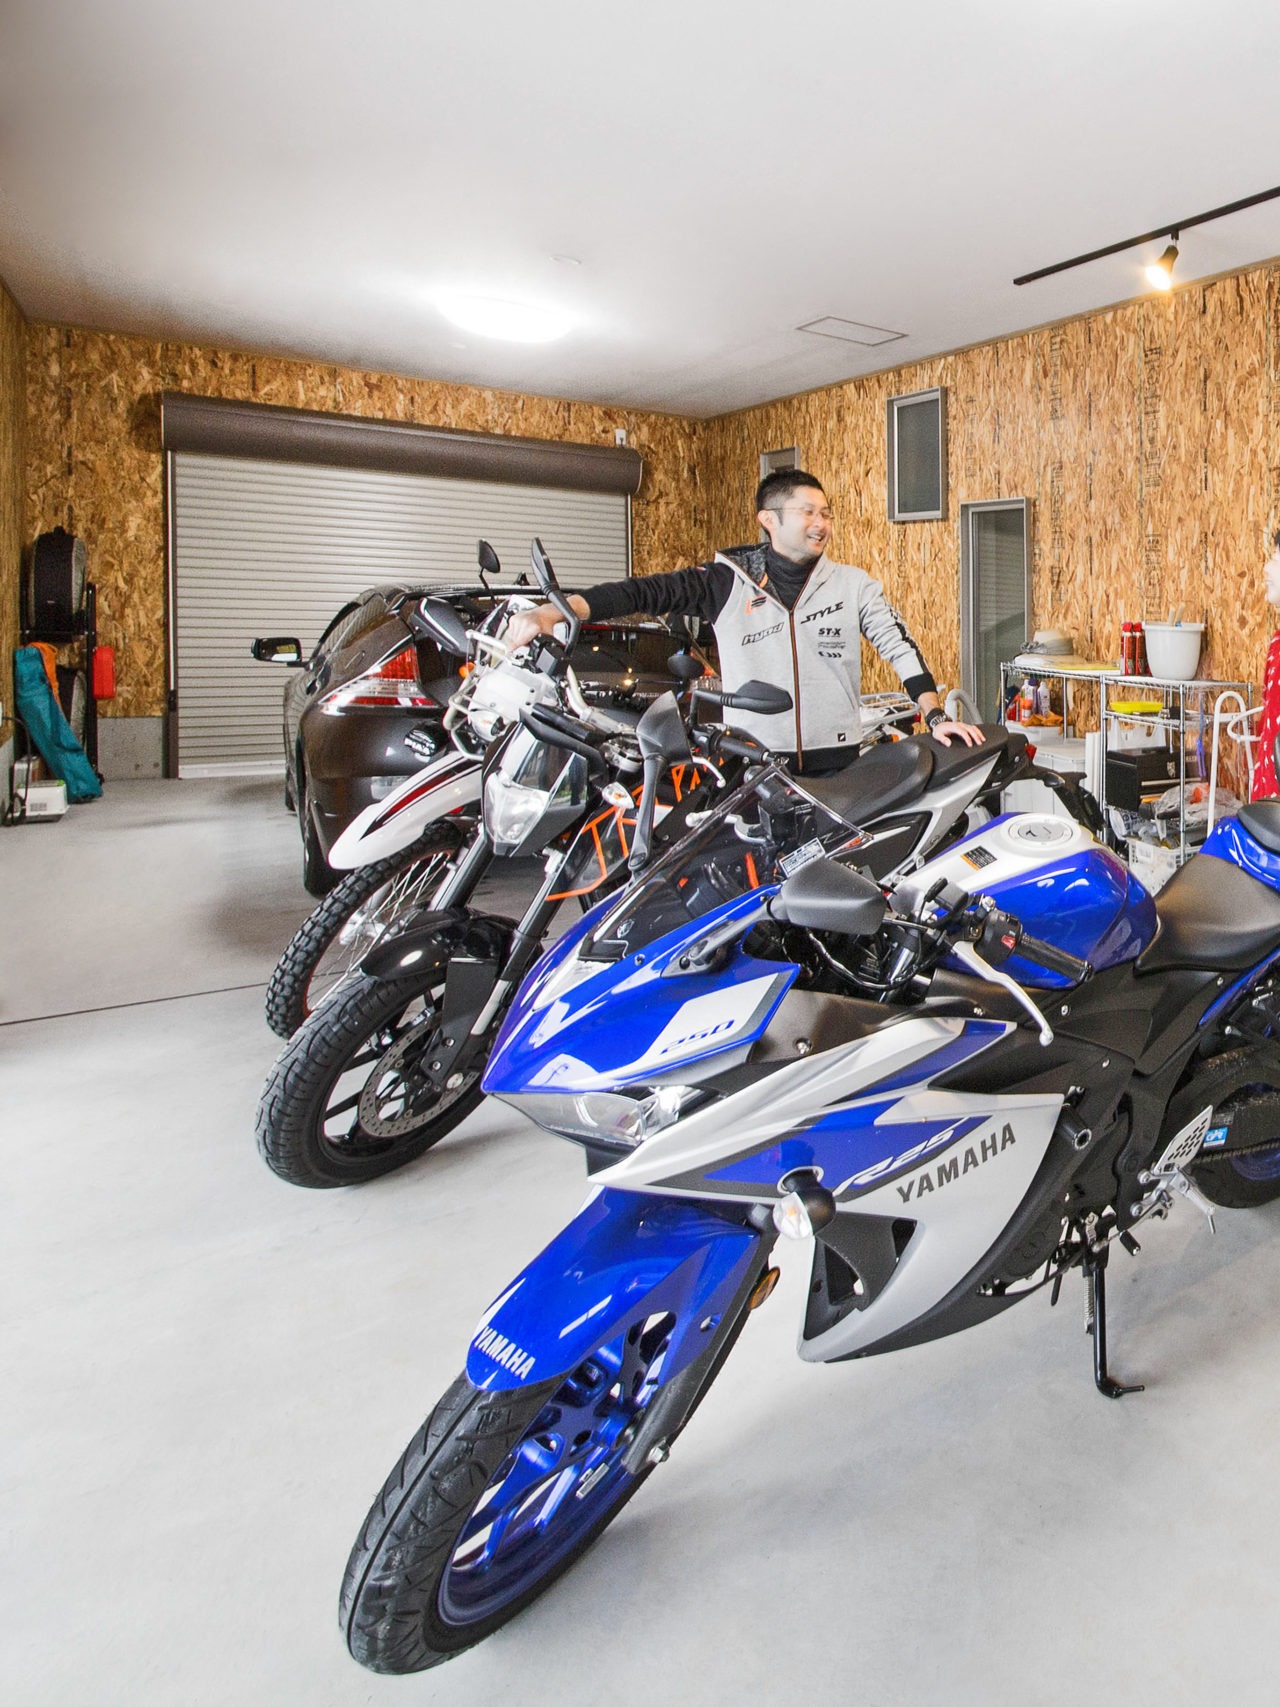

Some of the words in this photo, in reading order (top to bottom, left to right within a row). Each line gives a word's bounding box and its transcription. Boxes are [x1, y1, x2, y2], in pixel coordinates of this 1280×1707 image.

[800, 601, 844, 625] STYLE
[660, 1018, 735, 1055] 250
[832, 1117, 968, 1197] R25
[896, 1122, 1017, 1204] YAMAHA
[473, 1326, 536, 1381] YAMAHA
